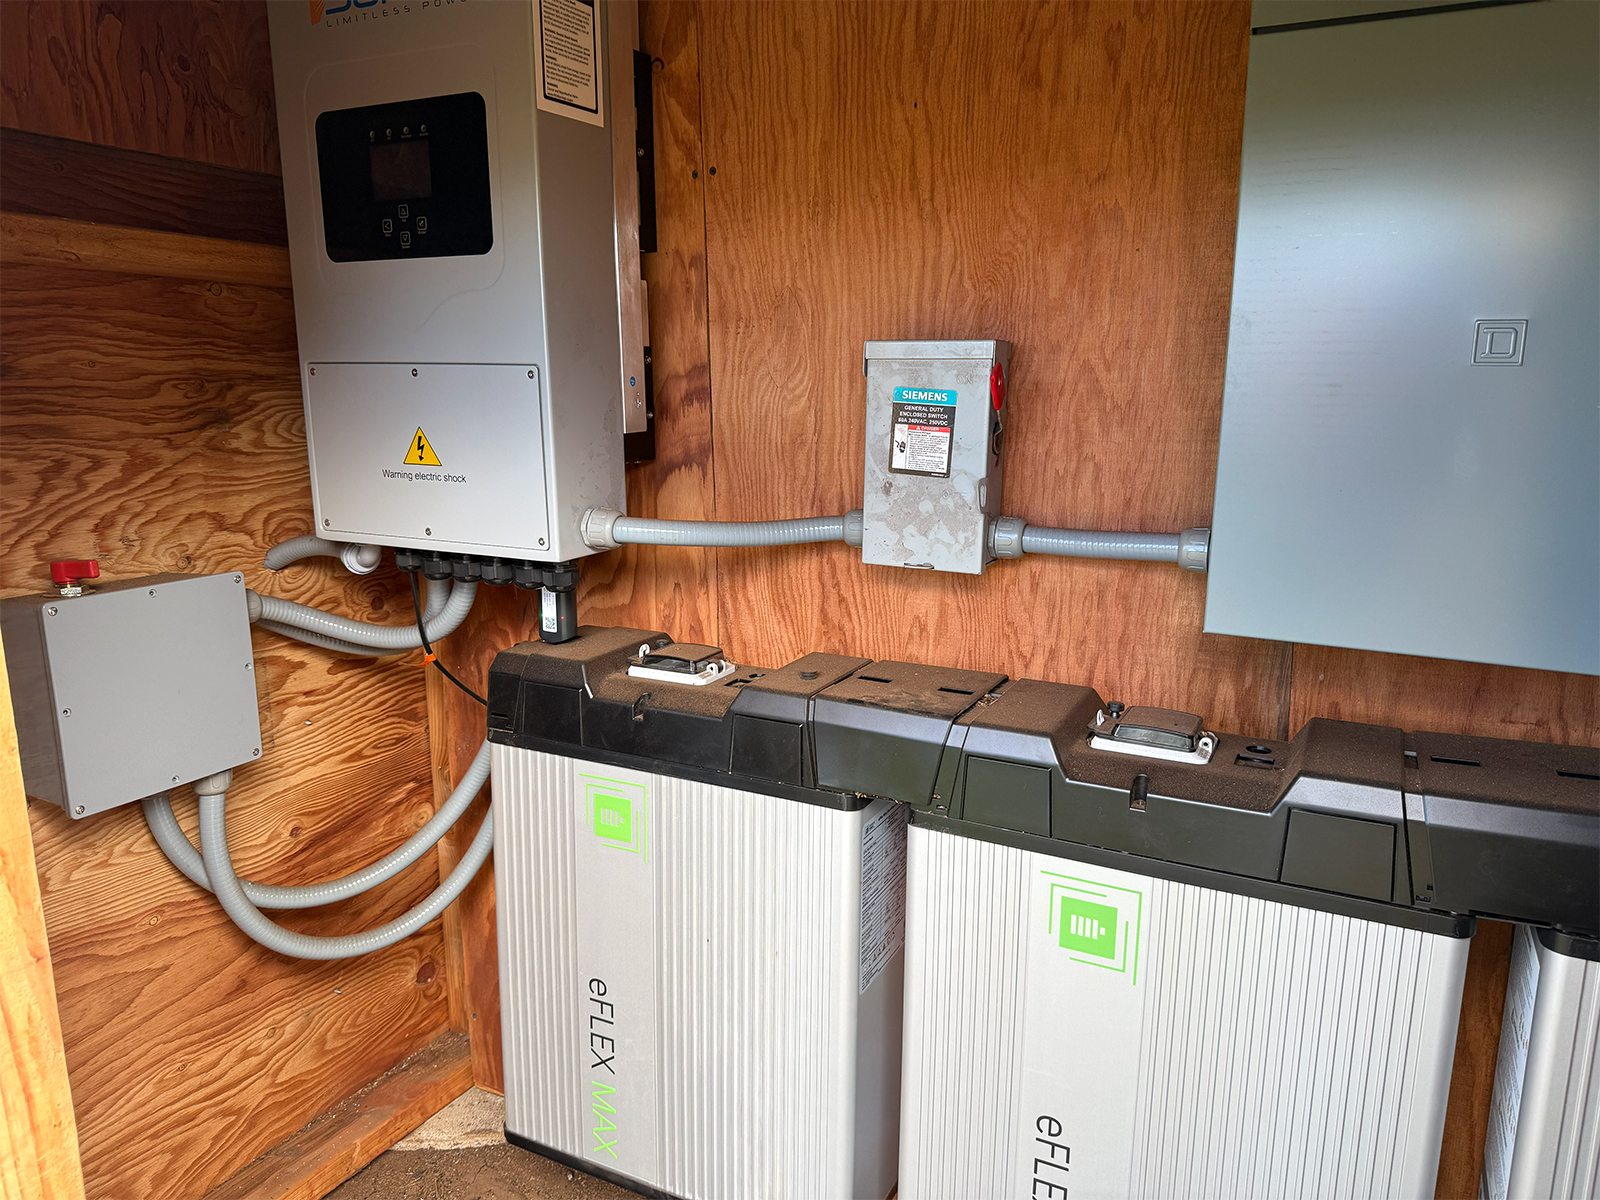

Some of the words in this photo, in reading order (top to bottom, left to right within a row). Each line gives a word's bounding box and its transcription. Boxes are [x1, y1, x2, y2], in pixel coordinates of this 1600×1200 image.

[326, 5, 411, 28] LIMITLESS
[422, 0, 467, 9] POW
[902, 390, 948, 402] SIEMENS
[382, 469, 413, 482] Warning
[414, 471, 442, 482] electric
[443, 473, 467, 483] shock
[588, 977, 616, 1075] eFLEX
[591, 1080, 618, 1160] MAX
[1032, 1115, 1071, 1200] eFLE
